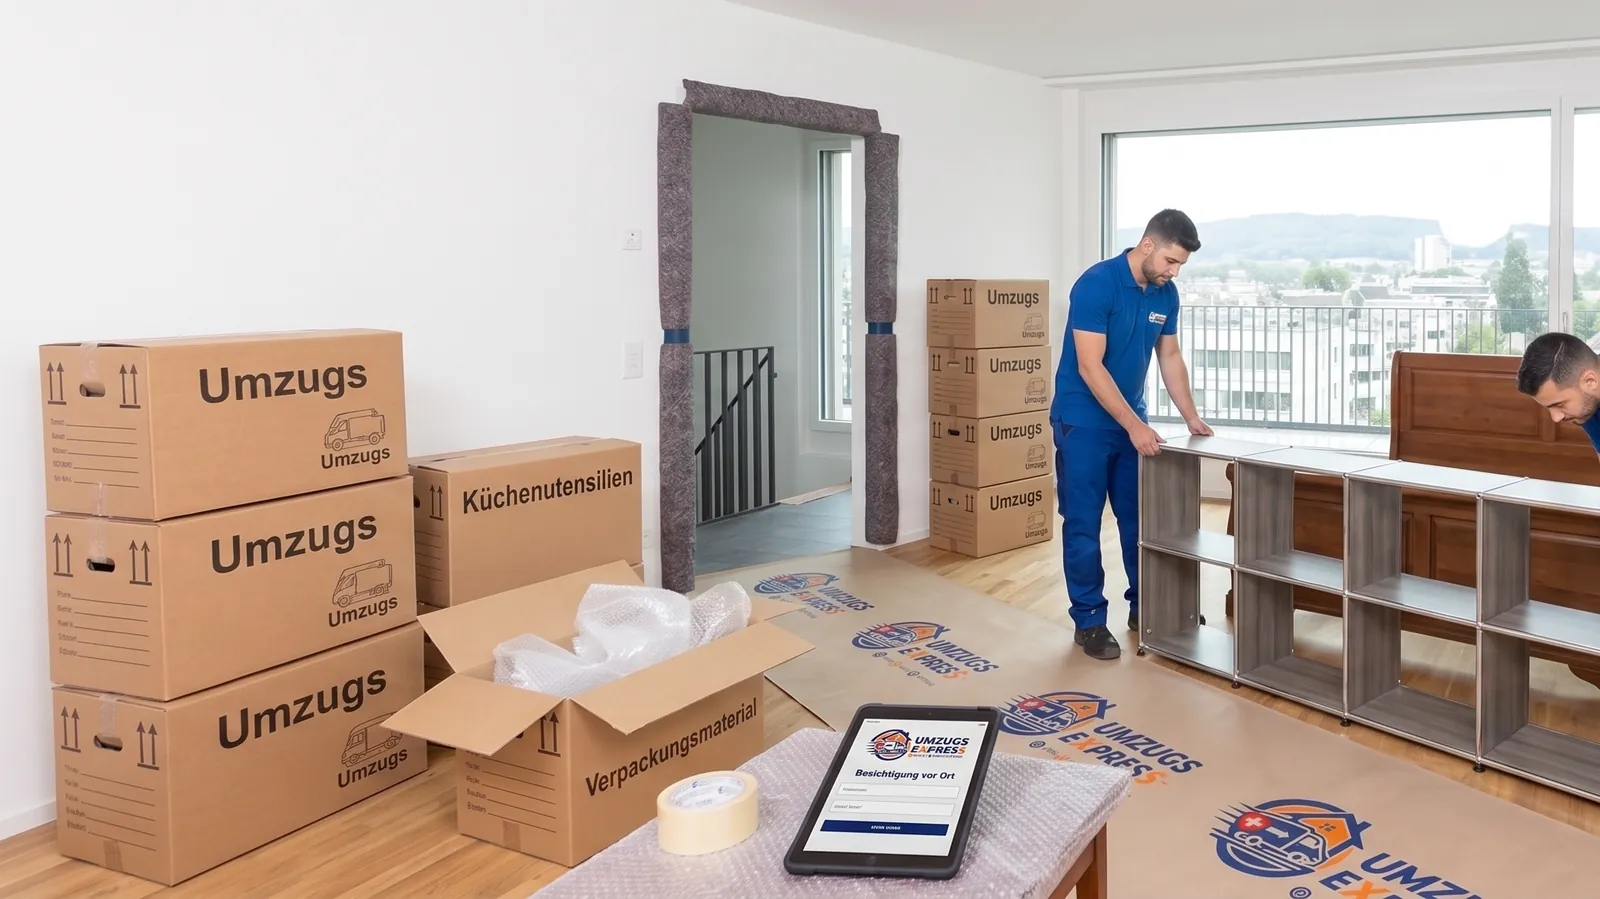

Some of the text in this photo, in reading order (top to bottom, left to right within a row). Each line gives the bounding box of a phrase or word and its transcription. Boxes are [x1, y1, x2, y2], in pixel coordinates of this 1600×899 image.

[987, 289, 1040, 308] Umzugs
[199, 364, 369, 404] Umzugs
[989, 357, 1042, 374] Umzugs
[990, 423, 1042, 441] Umzugs
[320, 445, 391, 470] Umzugs
[462, 468, 634, 515] Küchenutensilien
[989, 489, 1042, 511] Umzugs
[211, 515, 378, 574] Umzugs
[328, 594, 398, 628] Umzugs
[925, 639, 999, 673] UMZUGS
[218, 669, 387, 750] Umzugs
[585, 697, 758, 797] Verpackungsmaterial
[915, 736, 970, 746] UMZUGS
[1057, 731, 1168, 785] EXPRESS
[1092, 721, 1203, 774] UMZUGS
[337, 747, 408, 789] Umzugs
[855, 769, 919, 781] Besichtigung
[940, 771, 956, 780] Ort
[1360, 852, 1483, 899] UMZ
